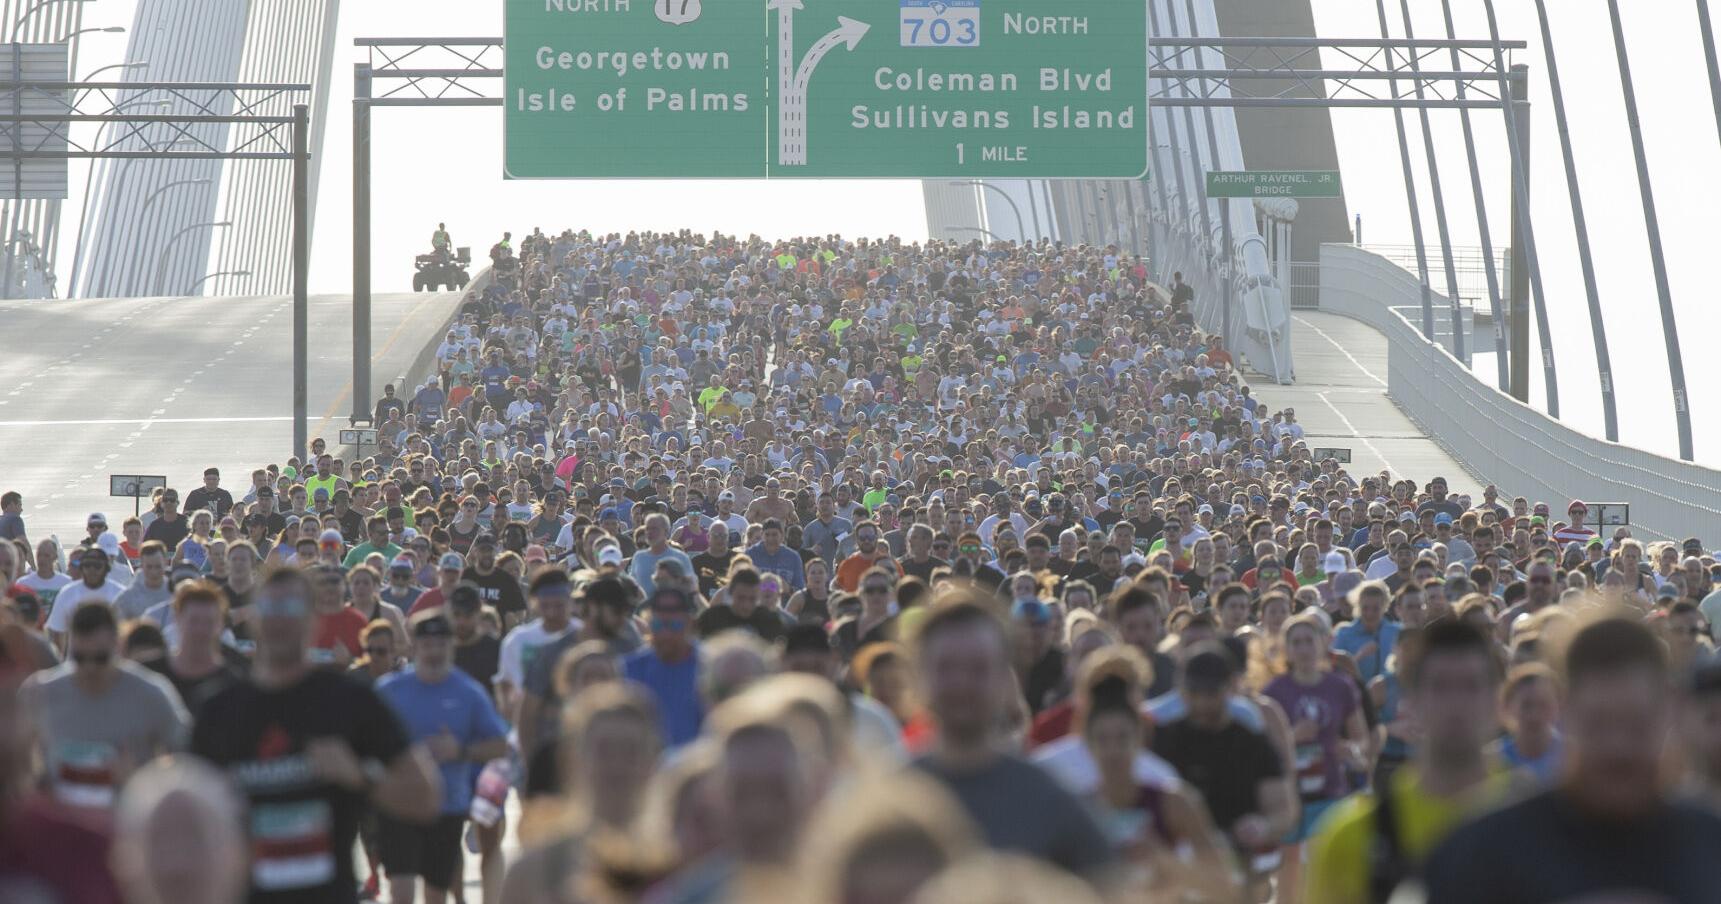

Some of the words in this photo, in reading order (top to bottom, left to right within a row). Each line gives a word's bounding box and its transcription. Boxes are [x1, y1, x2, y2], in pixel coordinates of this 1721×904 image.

[545, 0, 630, 12] NORTH
[665, 0, 689, 16] 17
[903, 18, 976, 45] 703
[1004, 13, 1088, 34] NORTH
[535, 45, 729, 77] Georgetown
[874, 67, 1017, 91] Coleman
[1039, 67, 1111, 91] Blvd
[518, 88, 576, 112] Isle
[597, 88, 627, 112] of
[647, 88, 748, 112] Palms
[851, 105, 1010, 129] Sullivans
[1033, 105, 1134, 129] Island
[956, 143, 964, 165] 1
[982, 146, 1028, 161] MILE
[1213, 174, 1255, 183] ARTHUR
[1260, 174, 1312, 184] RAVENEL,
[1254, 185, 1293, 194] BRIDGE
